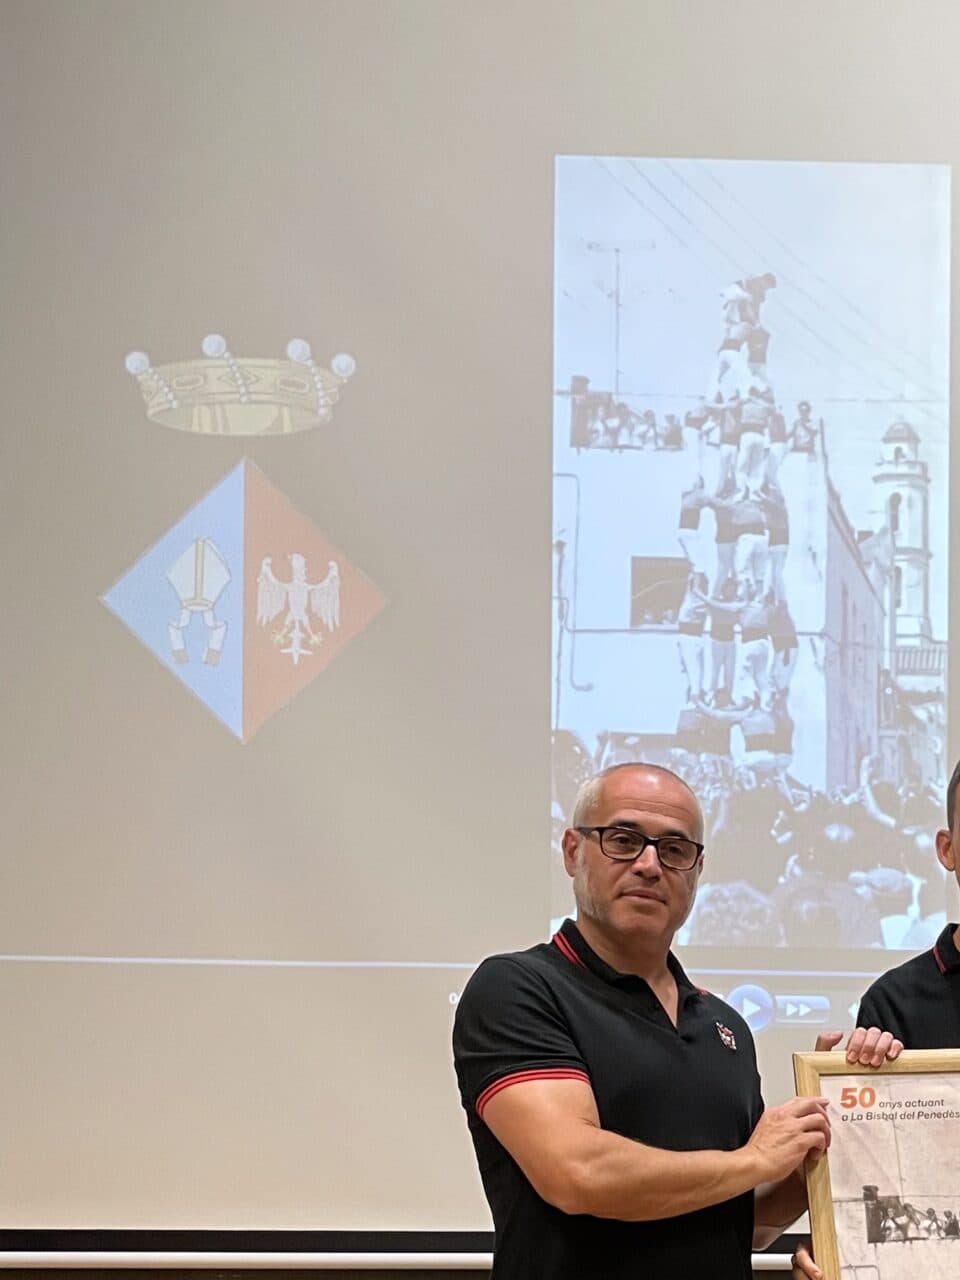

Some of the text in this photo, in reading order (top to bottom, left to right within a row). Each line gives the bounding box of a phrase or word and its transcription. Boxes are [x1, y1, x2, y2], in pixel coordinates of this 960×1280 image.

[840, 1087, 945, 1109] 50 anys actuant
[850, 1112, 863, 1121] La
[866, 1111, 897, 1121] Bisbal
[900, 1111, 915, 1120] del
[917, 1110, 960, 1120] Penedès
